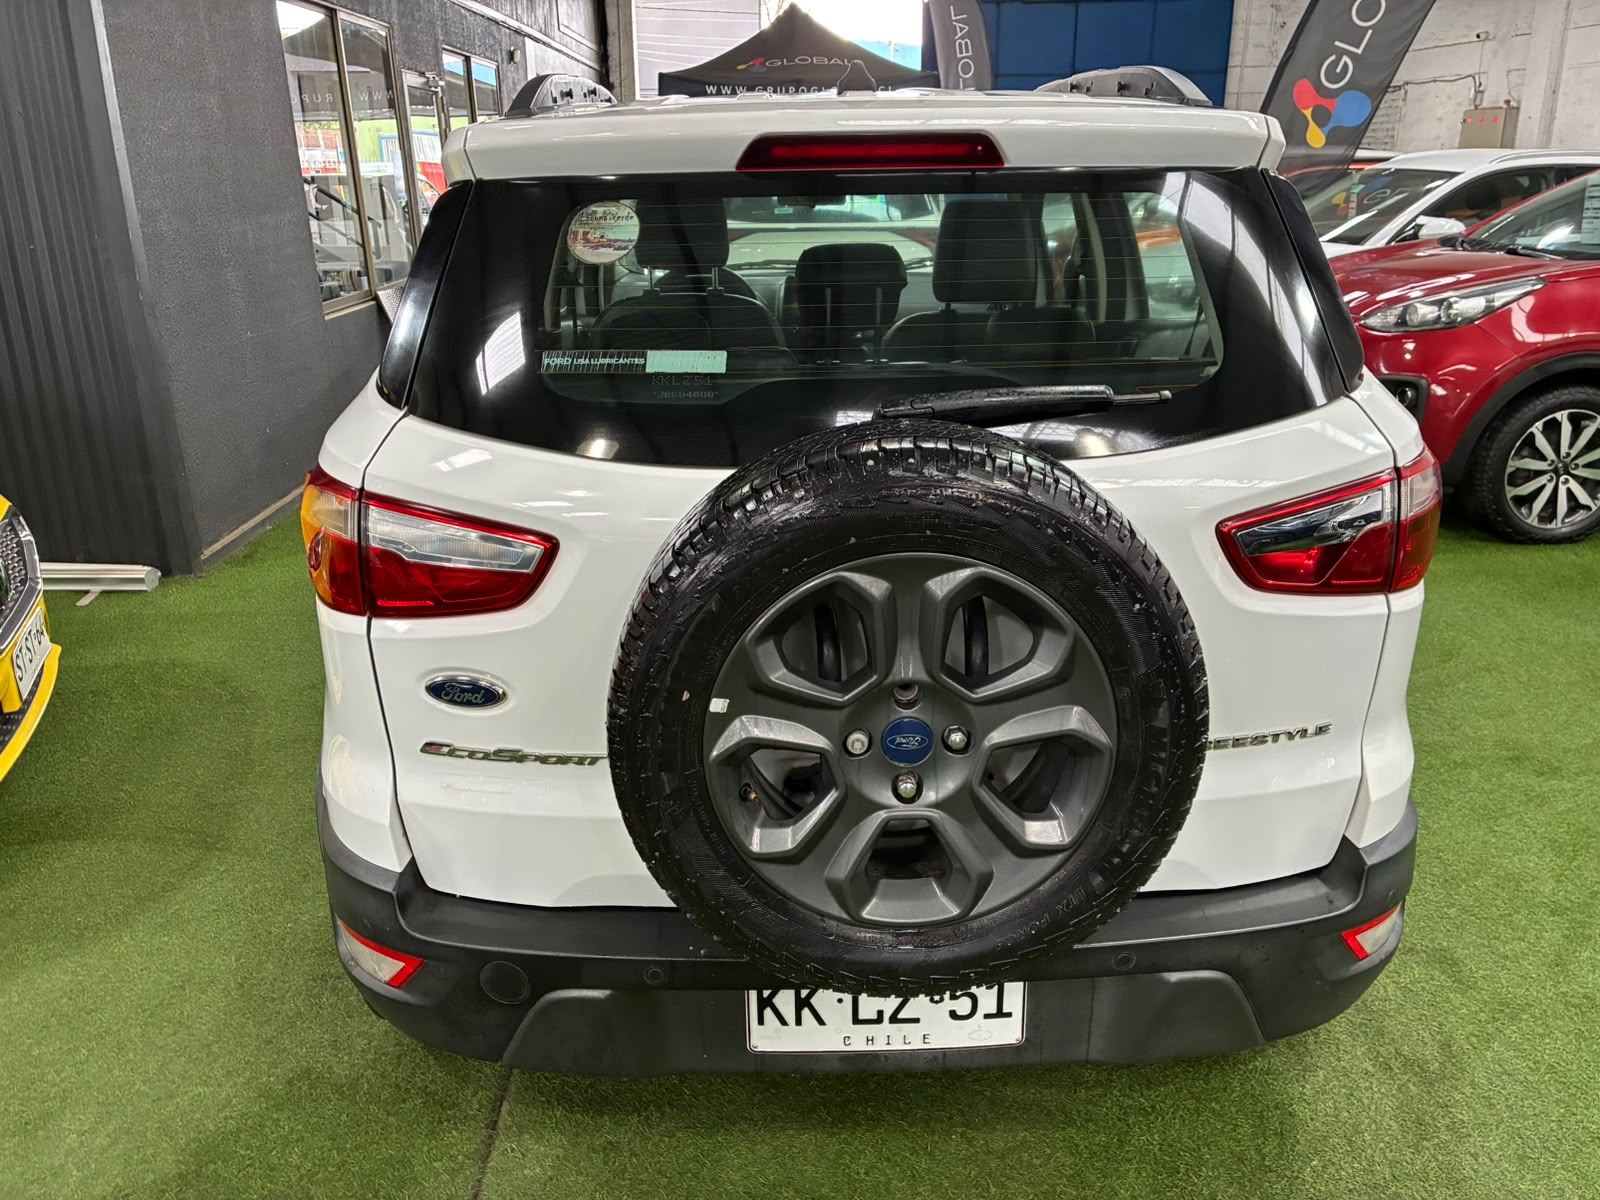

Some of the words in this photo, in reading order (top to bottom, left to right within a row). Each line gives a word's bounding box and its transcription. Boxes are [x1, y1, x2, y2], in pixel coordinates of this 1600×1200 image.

[544, 357, 572, 365] FORD
[573, 357, 590, 365] USA
[590, 357, 646, 365] LUBRICANTES
[441, 682, 485, 704] Ford
[843, 1033, 931, 1047] CHILE
